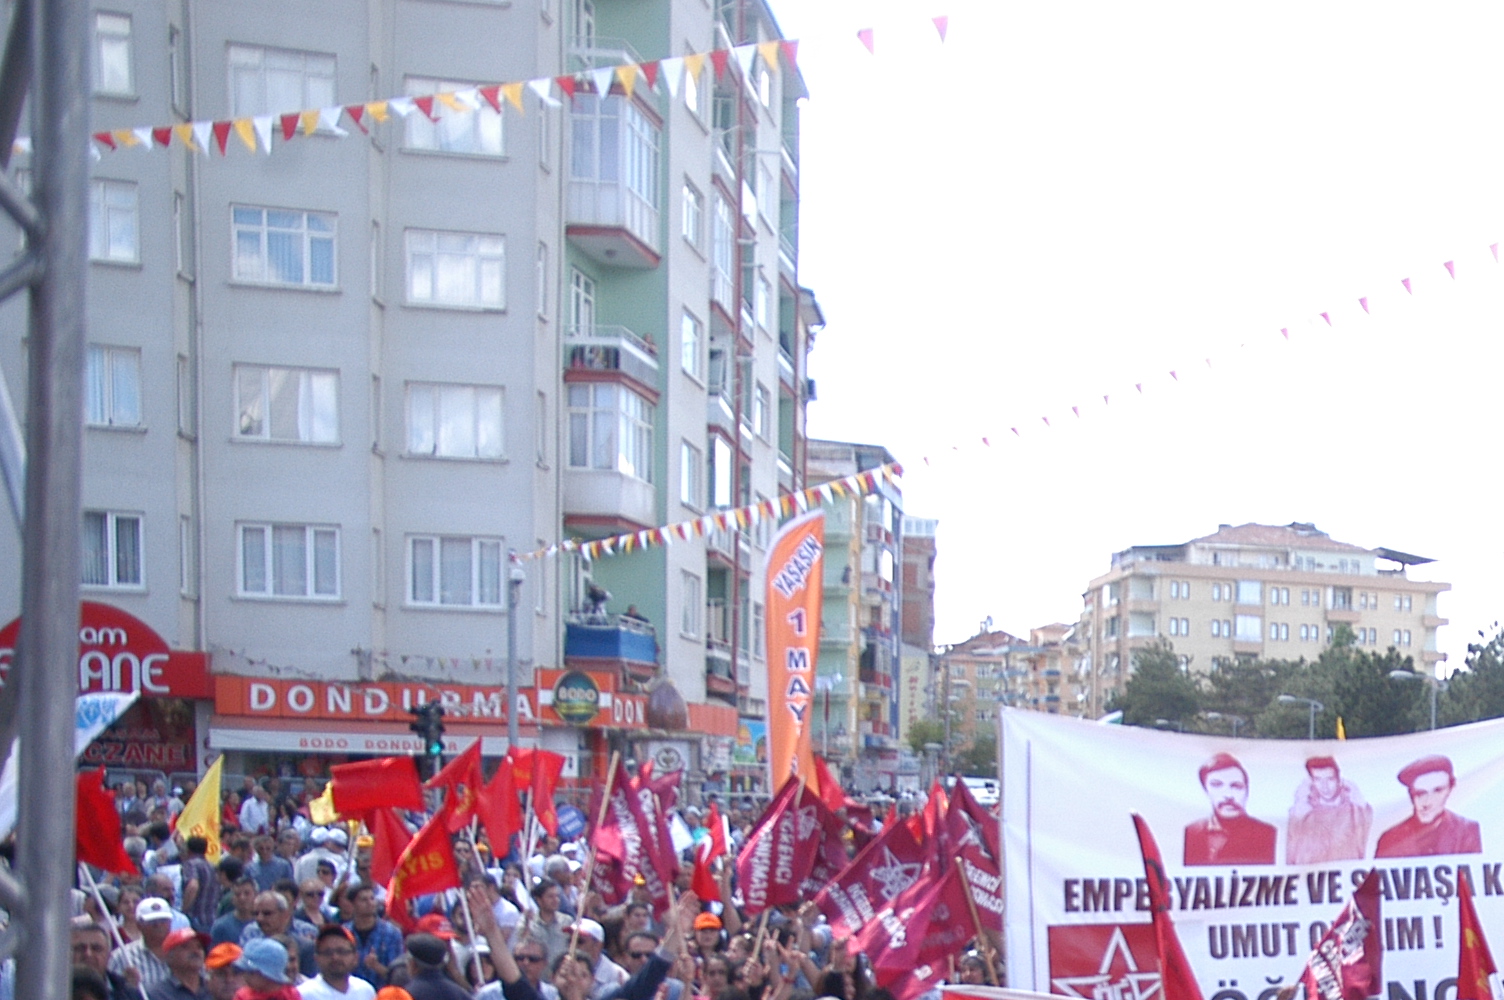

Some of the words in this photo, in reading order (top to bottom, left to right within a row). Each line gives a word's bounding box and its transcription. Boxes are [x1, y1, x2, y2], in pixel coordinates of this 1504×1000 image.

[787, 608, 806, 637] 1
[249, 683, 534, 719] DONDURMA
[298, 738, 348, 749] BODO
[1064, 870, 1300, 913] EMPEYALİZME
[1306, 870, 1342, 905] VE
[1208, 922, 1300, 960] UMUT
[1309, 914, 1425, 954] OIM
